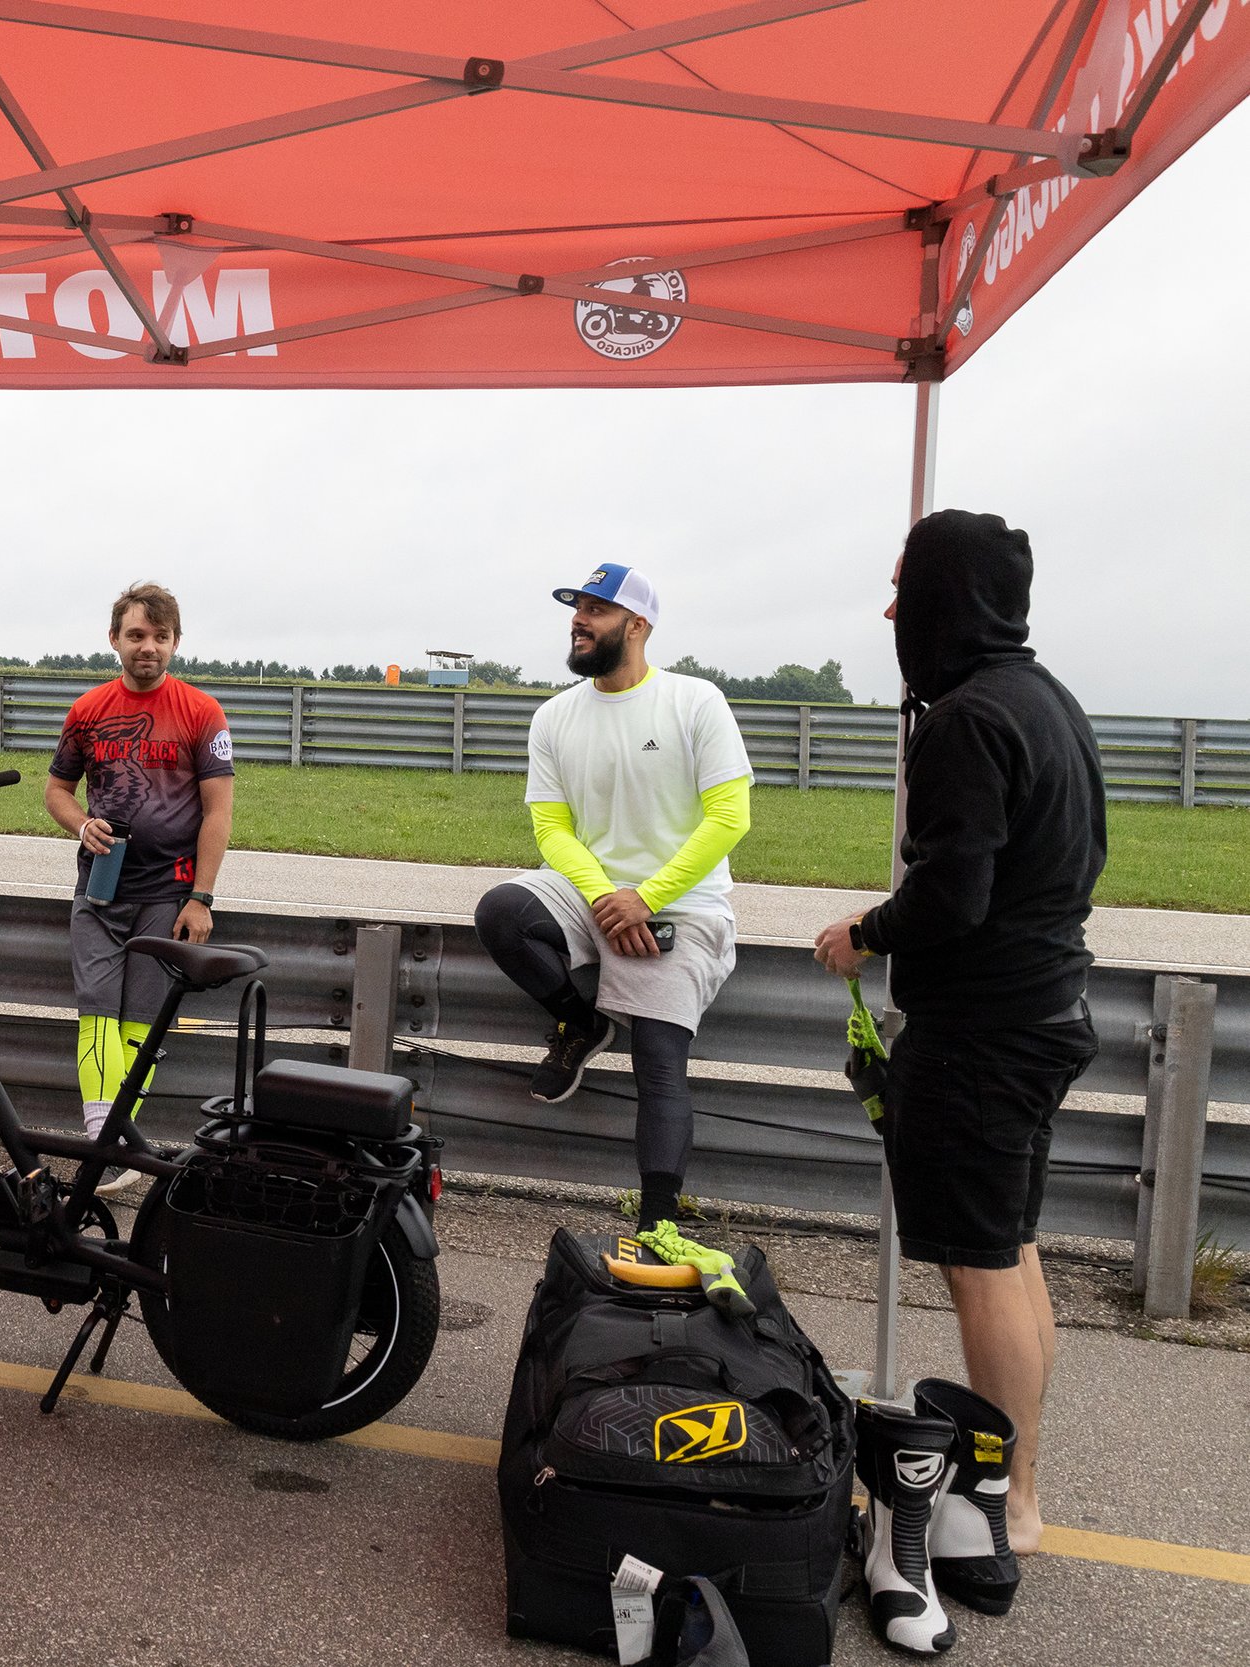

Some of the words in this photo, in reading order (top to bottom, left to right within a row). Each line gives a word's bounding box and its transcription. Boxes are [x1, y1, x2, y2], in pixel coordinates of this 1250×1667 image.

[93, 738, 132, 762] WOLF
[137, 738, 180, 762] PACK
[174, 856, 194, 882] 13
